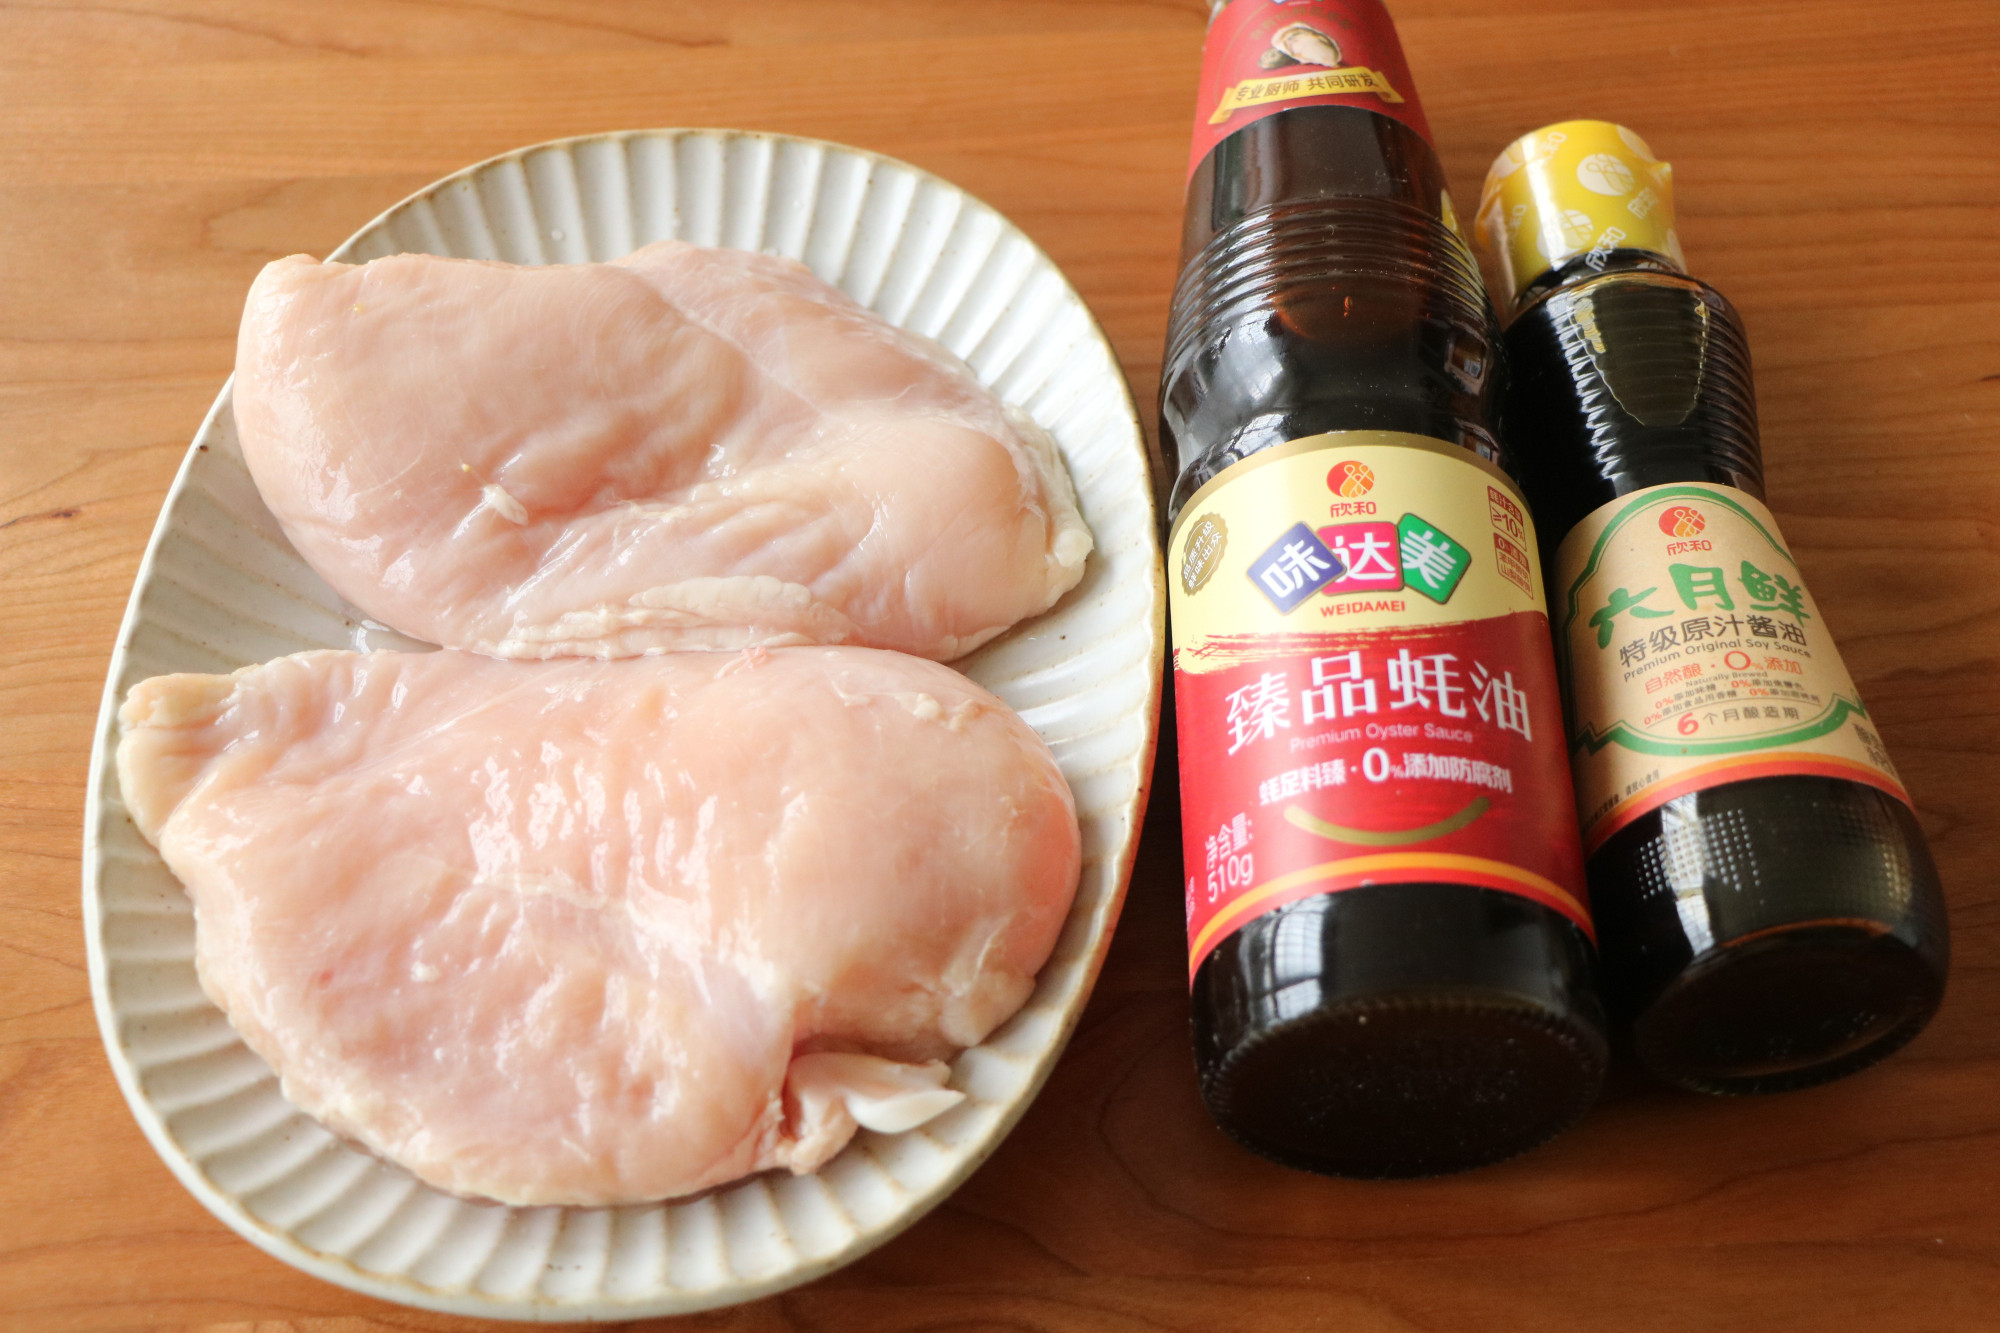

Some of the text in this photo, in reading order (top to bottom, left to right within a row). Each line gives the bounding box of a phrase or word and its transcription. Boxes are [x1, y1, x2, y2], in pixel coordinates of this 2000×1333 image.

[1236, 73, 1378, 101] 专业厨师 共同研发
[1585, 226, 1627, 272] 欣和
[1330, 501, 1377, 518] 欣和
[1260, 530, 1457, 599] 味达美
[1667, 540, 1713, 556] 欣和
[1320, 600, 1407, 617] WEIDAMEI
[1589, 560, 1811, 650] 六月鲜
[1620, 614, 1807, 668] 特级原汁酱油
[1624, 638, 1811, 682] Premium Original Soy Sauce
[1686, 671, 1769, 688] Naturally Brewed
[1225, 649, 1533, 756] 臻品蚝油
[1677, 705, 1801, 736] 6个月酿造期
[1290, 723, 1473, 753] Premium Oyster Sauce
[1208, 853, 1254, 904] 510g
